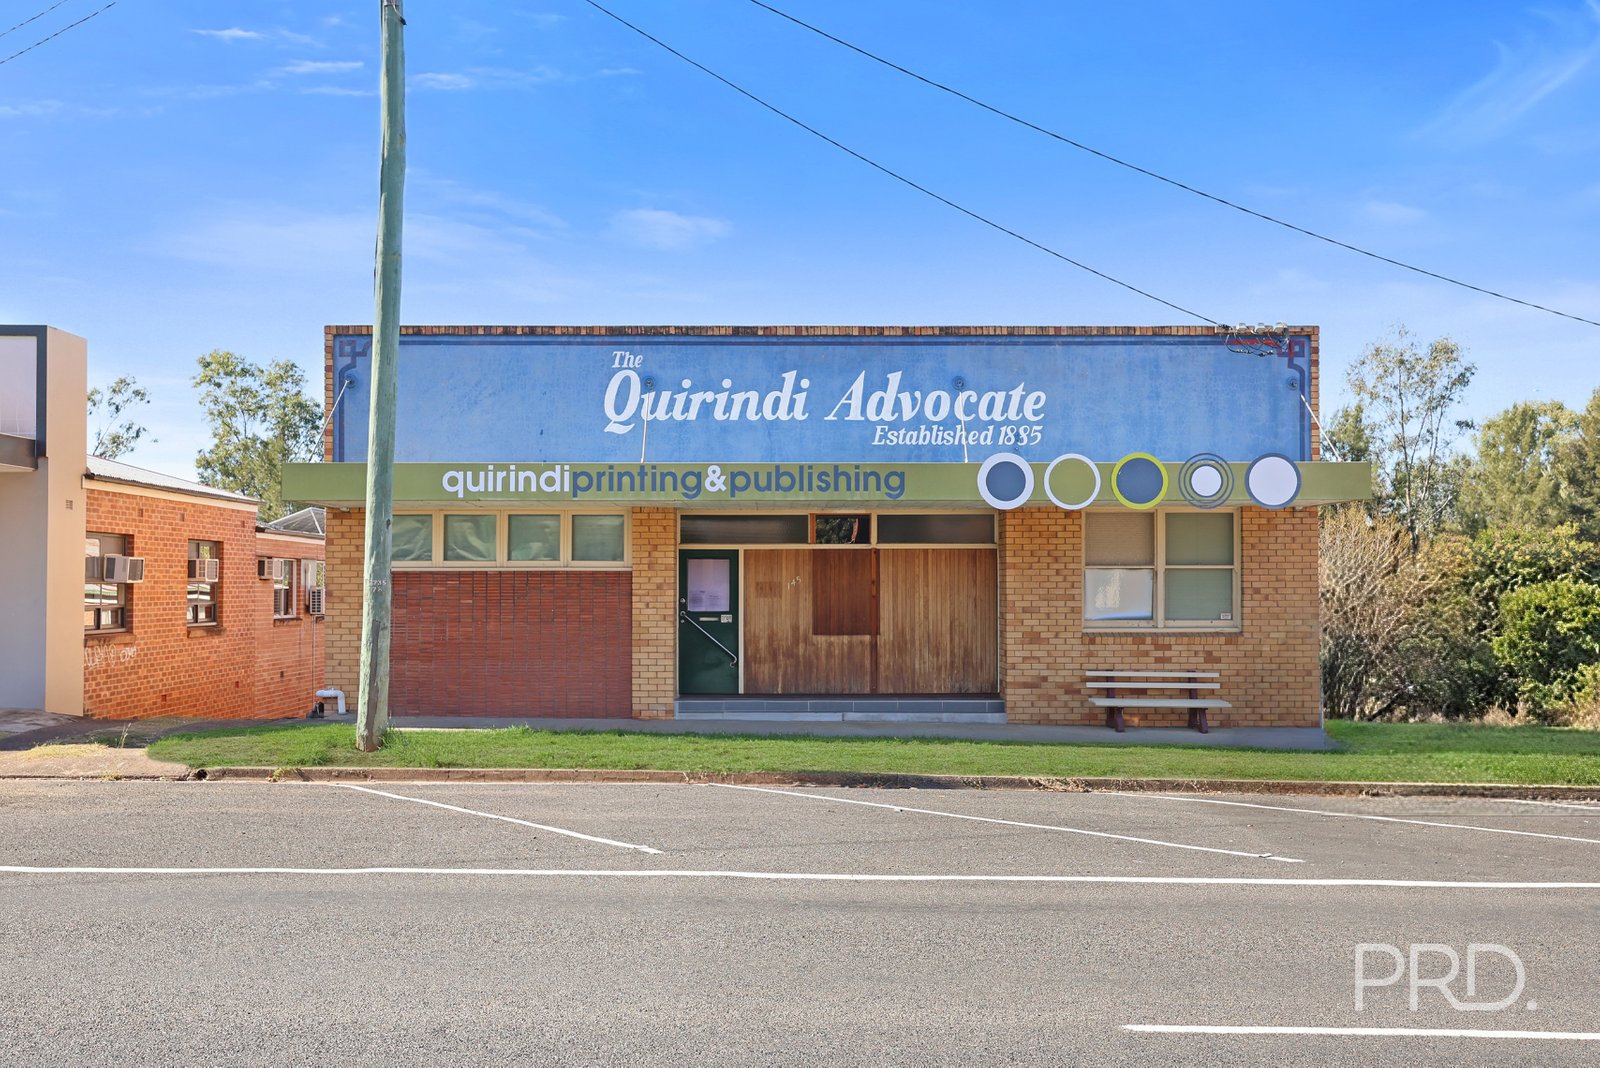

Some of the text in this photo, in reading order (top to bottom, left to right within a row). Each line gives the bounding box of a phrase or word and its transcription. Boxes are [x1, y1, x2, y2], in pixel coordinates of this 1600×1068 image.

[611, 351, 643, 368] The
[603, 369, 1046, 434] Quirindi Advocate
[872, 425, 1043, 445] Established 1885
